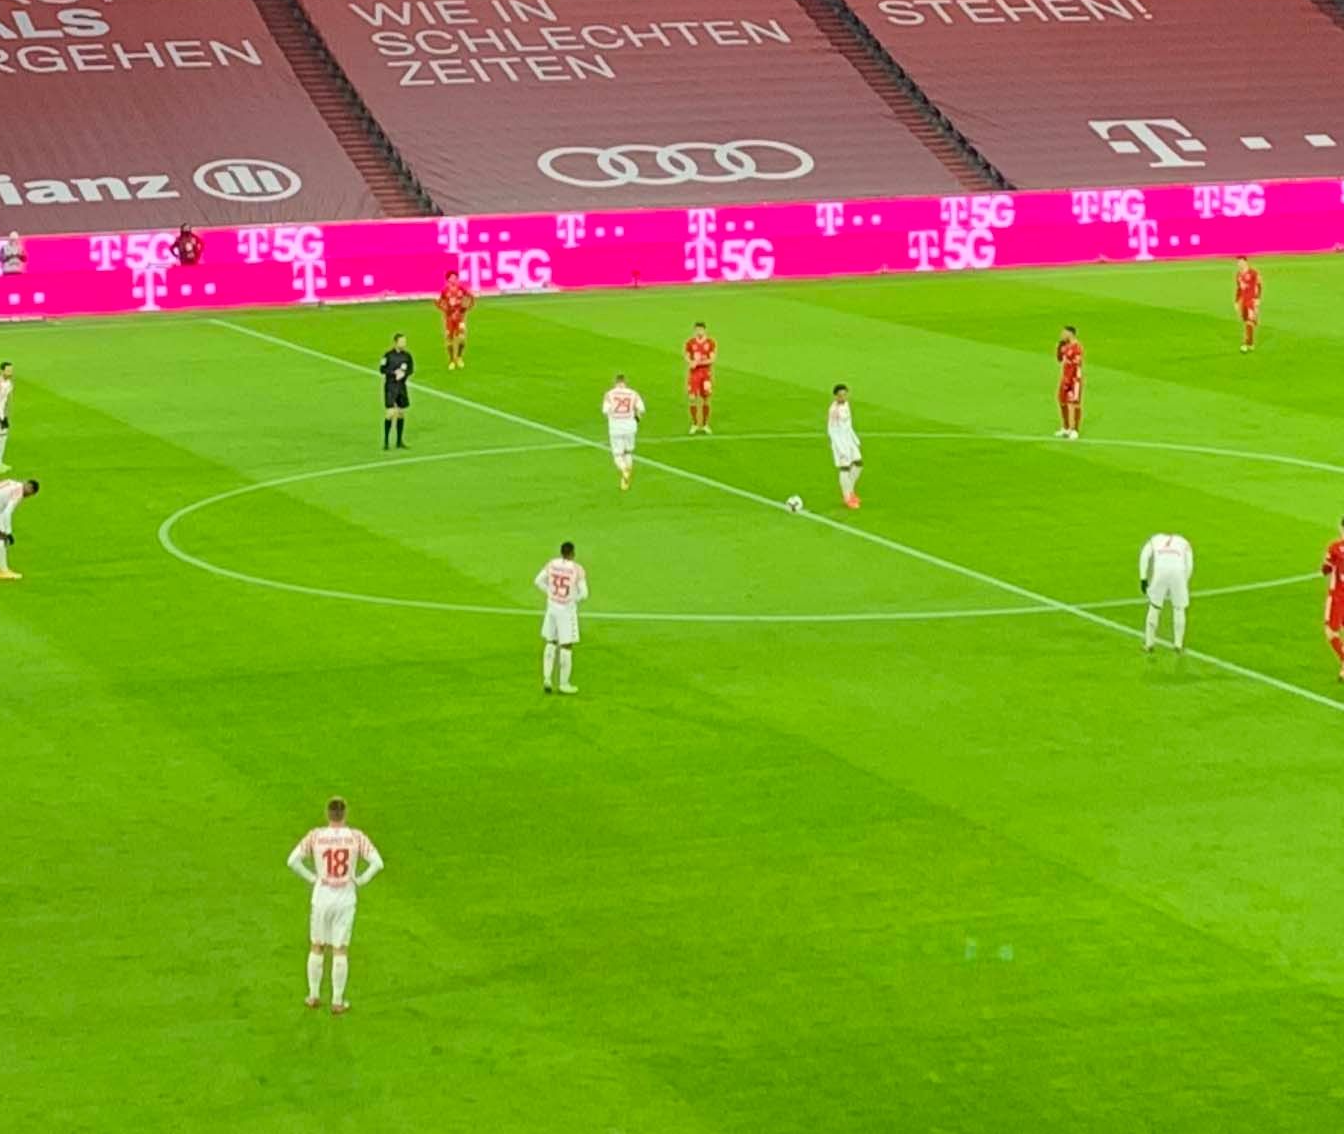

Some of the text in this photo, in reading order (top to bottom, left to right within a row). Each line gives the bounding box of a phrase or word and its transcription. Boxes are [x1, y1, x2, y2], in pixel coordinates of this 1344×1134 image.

[371, 18, 792, 57] SCHLECHTEN
[387, 53, 616, 87] ZEITEN
[551, 574, 571, 597] 35
[322, 848, 350, 878] 18
